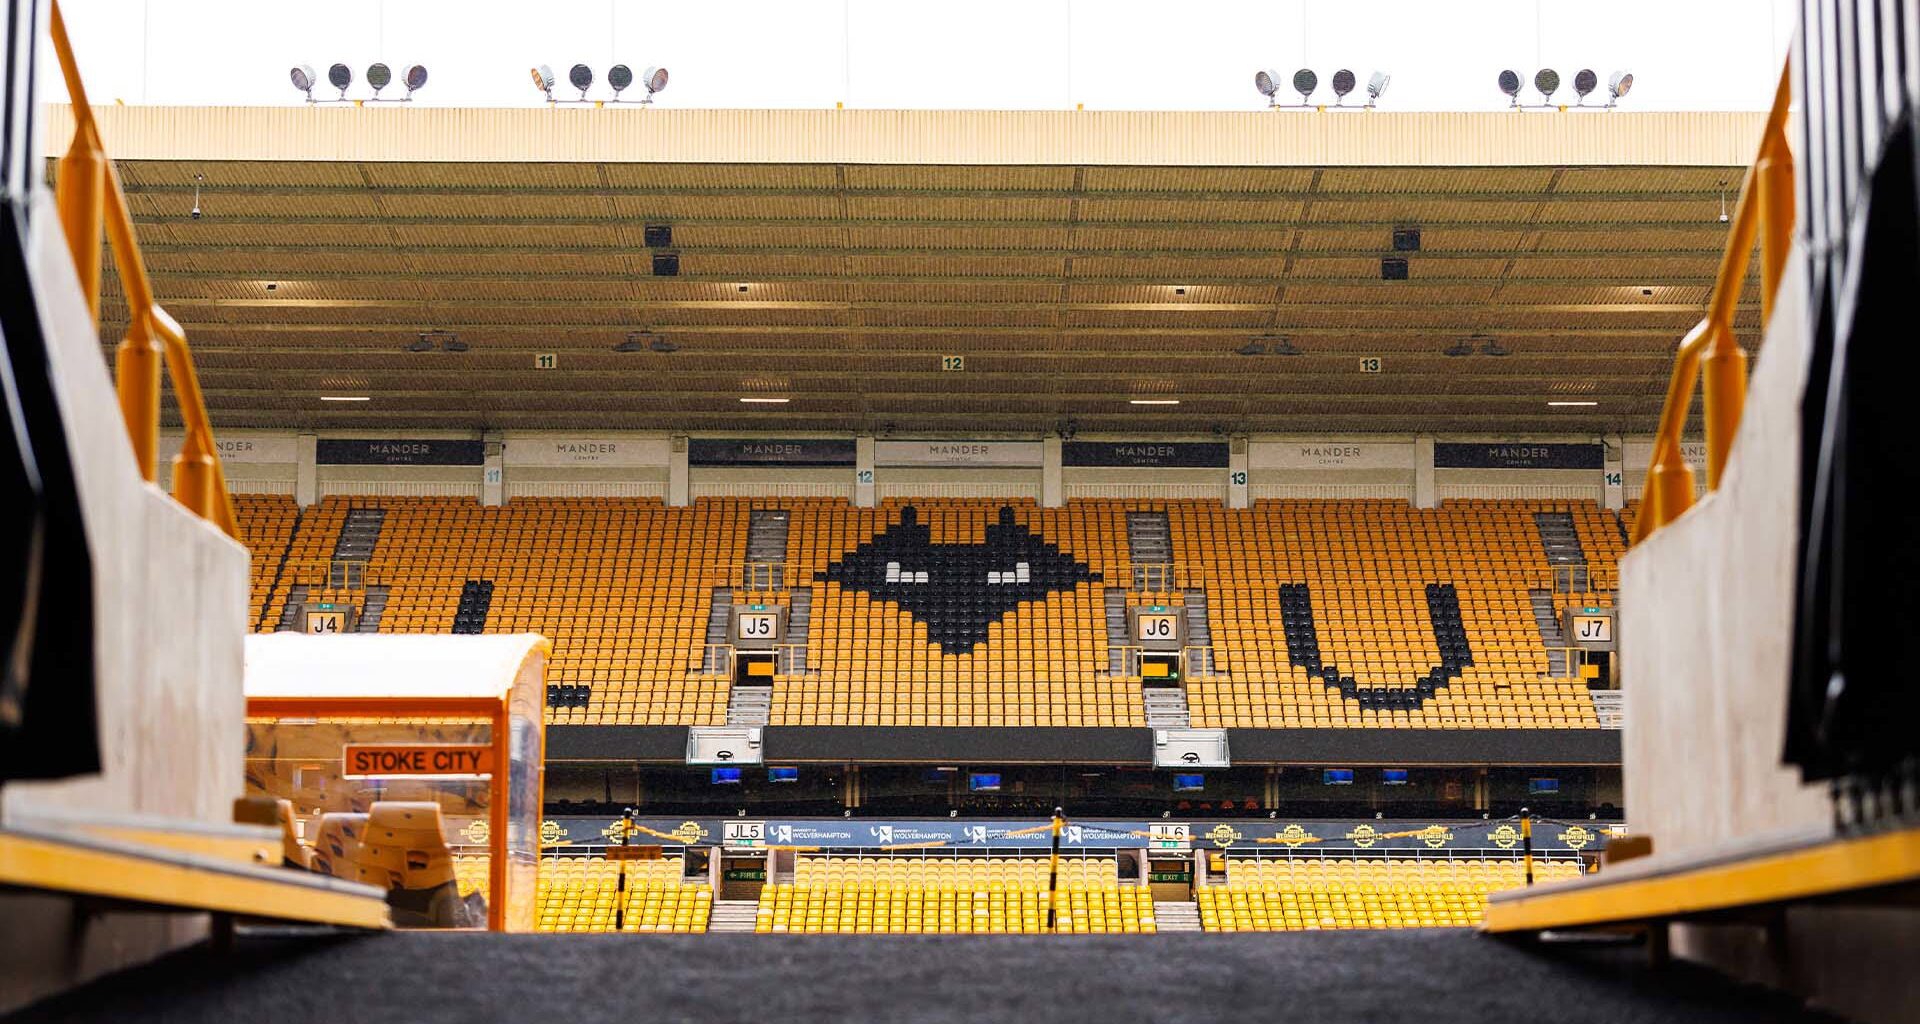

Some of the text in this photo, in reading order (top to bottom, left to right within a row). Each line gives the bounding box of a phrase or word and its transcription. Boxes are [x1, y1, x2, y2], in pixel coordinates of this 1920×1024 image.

[538, 355, 553, 368] 11
[944, 357, 961, 370] 12
[1361, 359, 1379, 371] 13
[370, 444, 430, 454] MANDER
[557, 444, 616, 453] MANDER
[744, 444, 801, 454] MANDER
[930, 445, 988, 455] MANDER
[1115, 447, 1175, 457] MANDER
[1302, 447, 1360, 457] MANDER
[1488, 448, 1549, 458] MANDER
[487, 470, 500, 482] 11
[858, 470, 873, 483] 12
[1231, 472, 1246, 485] 13
[1606, 473, 1621, 485] 14
[315, 616, 337, 633] J4
[747, 618, 769, 635] J5
[1147, 619, 1169, 636] J6
[1582, 620, 1603, 637] J7
[355, 751, 481, 770] STOKE CITY
[731, 825, 759, 838] JL5
[1156, 826, 1184, 840] JL6
[740, 871, 756, 879] FIRE
